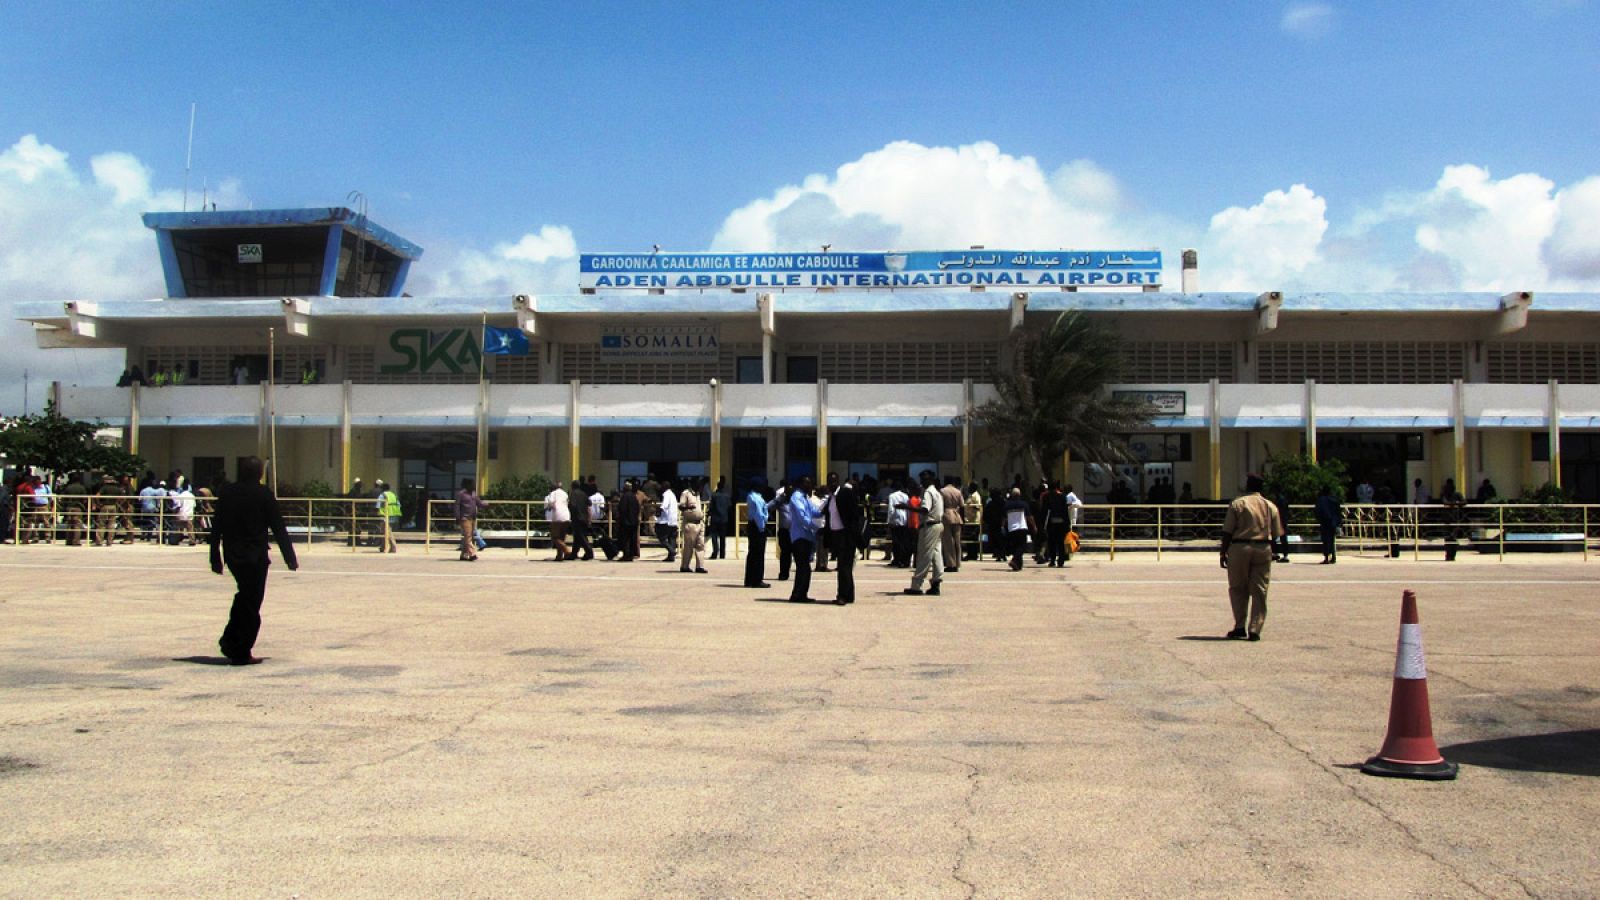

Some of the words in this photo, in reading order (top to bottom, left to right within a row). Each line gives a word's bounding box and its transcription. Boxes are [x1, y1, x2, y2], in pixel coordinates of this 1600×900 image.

[240, 246, 260, 255] SKA
[591, 257, 657, 270] GAROONKA
[662, 256, 731, 269] CAALAMIGA
[735, 256, 749, 268] EE
[751, 255, 793, 269] AADAN
[796, 255, 860, 269] CABDULLE
[595, 274, 668, 287] ADEN
[675, 273, 801, 287] ABDULLE
[811, 272, 1030, 286] INTERNATIONAL
[1038, 271, 1160, 285] AIRPORT
[622, 335, 718, 348] SOMALIA
[380, 328, 488, 374] SKA
